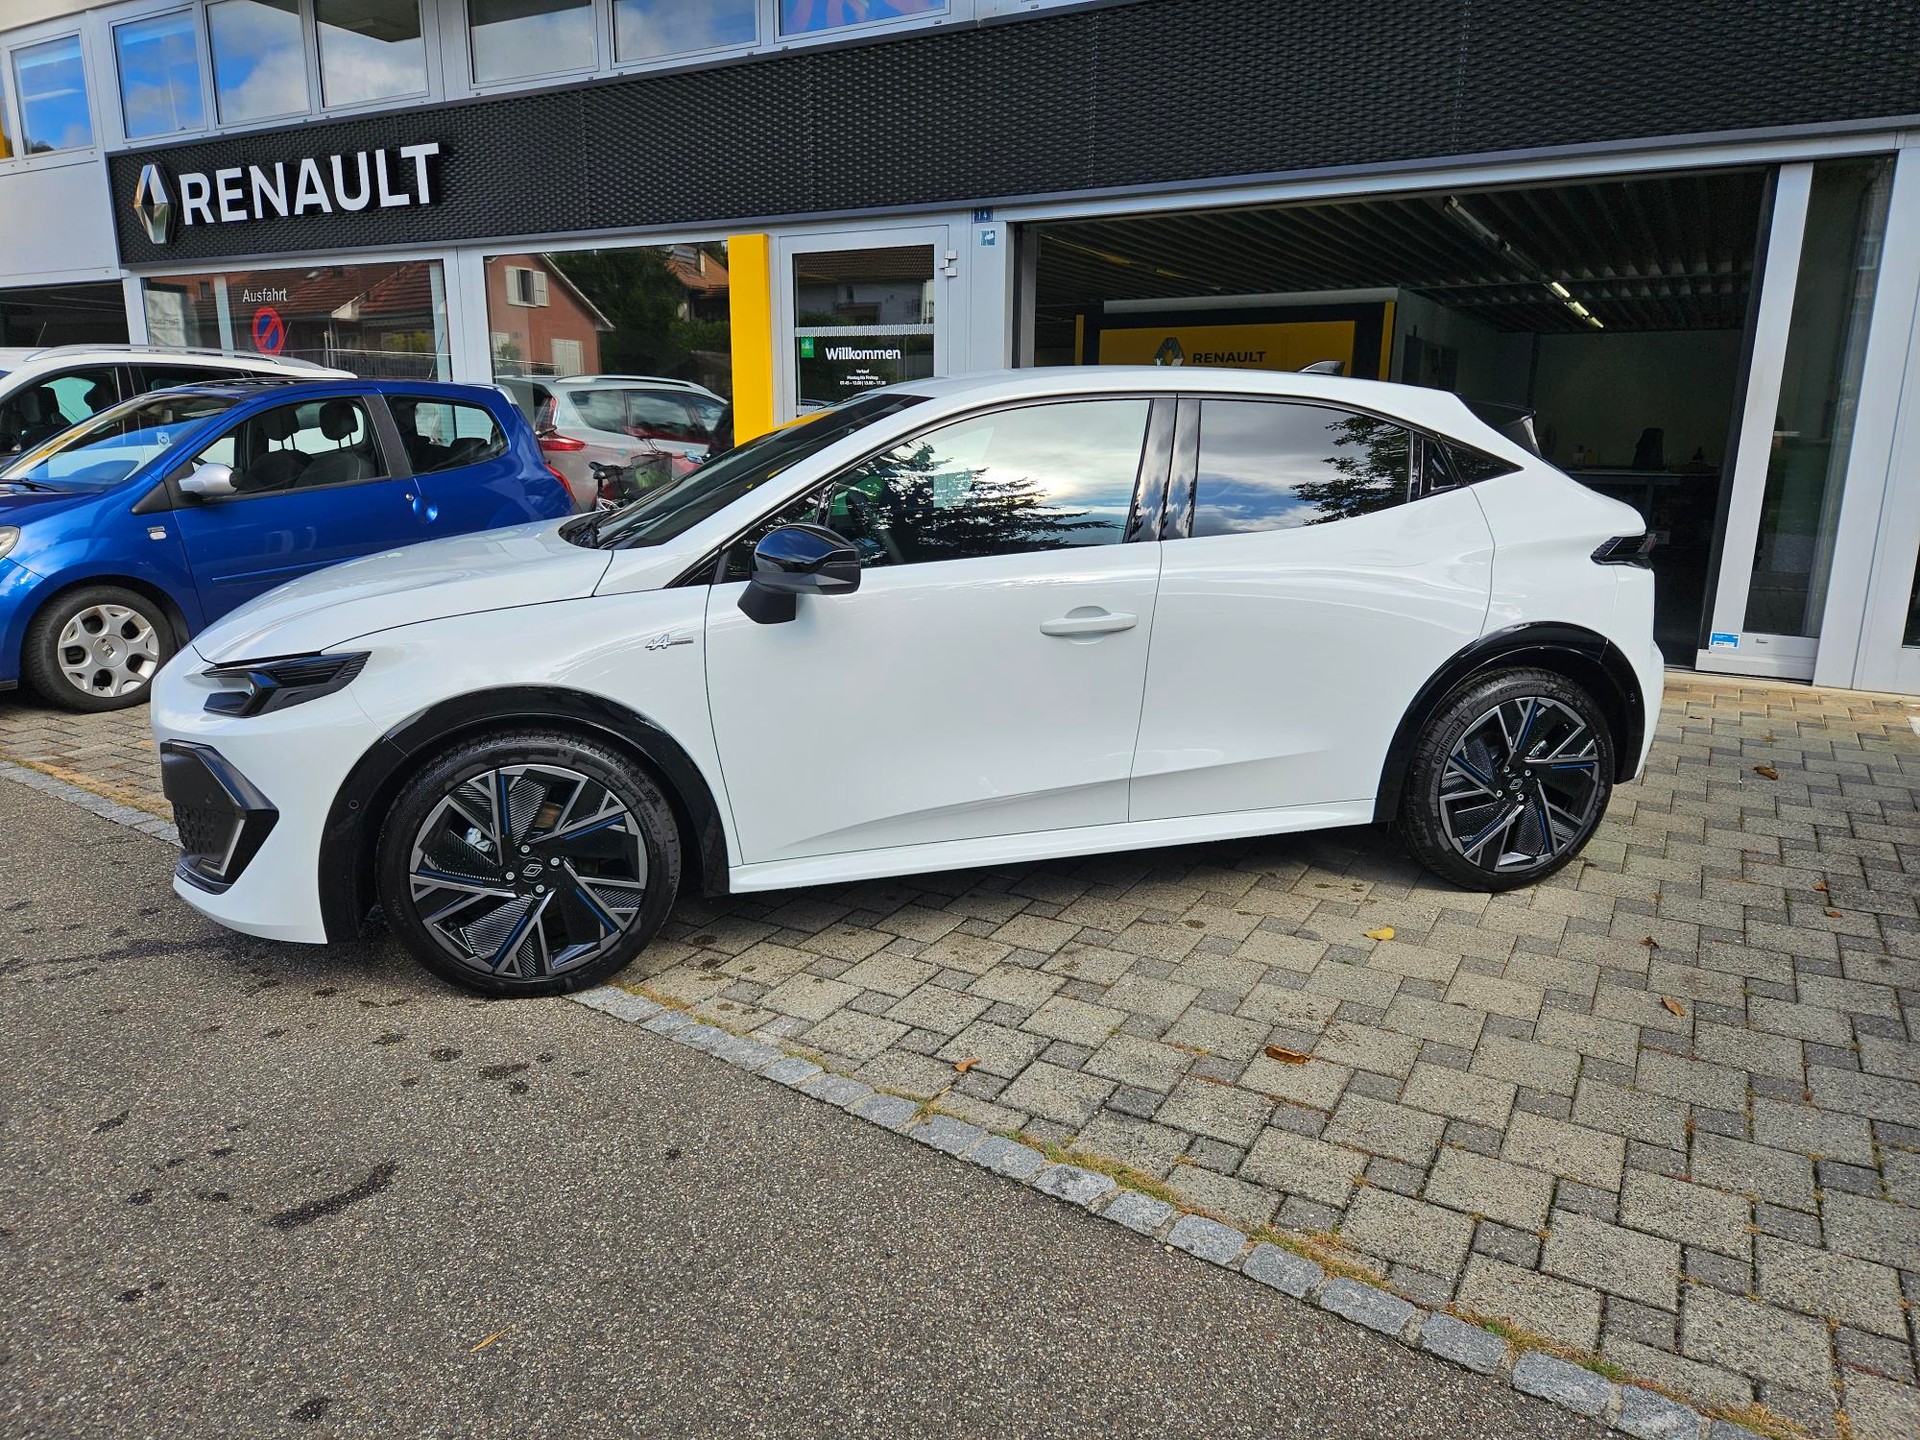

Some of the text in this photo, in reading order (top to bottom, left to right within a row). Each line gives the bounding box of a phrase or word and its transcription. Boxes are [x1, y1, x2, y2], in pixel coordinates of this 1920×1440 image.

[178, 142, 440, 226] RENAULT
[242, 287, 288, 303] Ausfahrt
[825, 347, 901, 360] Willkommen
[1192, 351, 1267, 364] RENAULT
